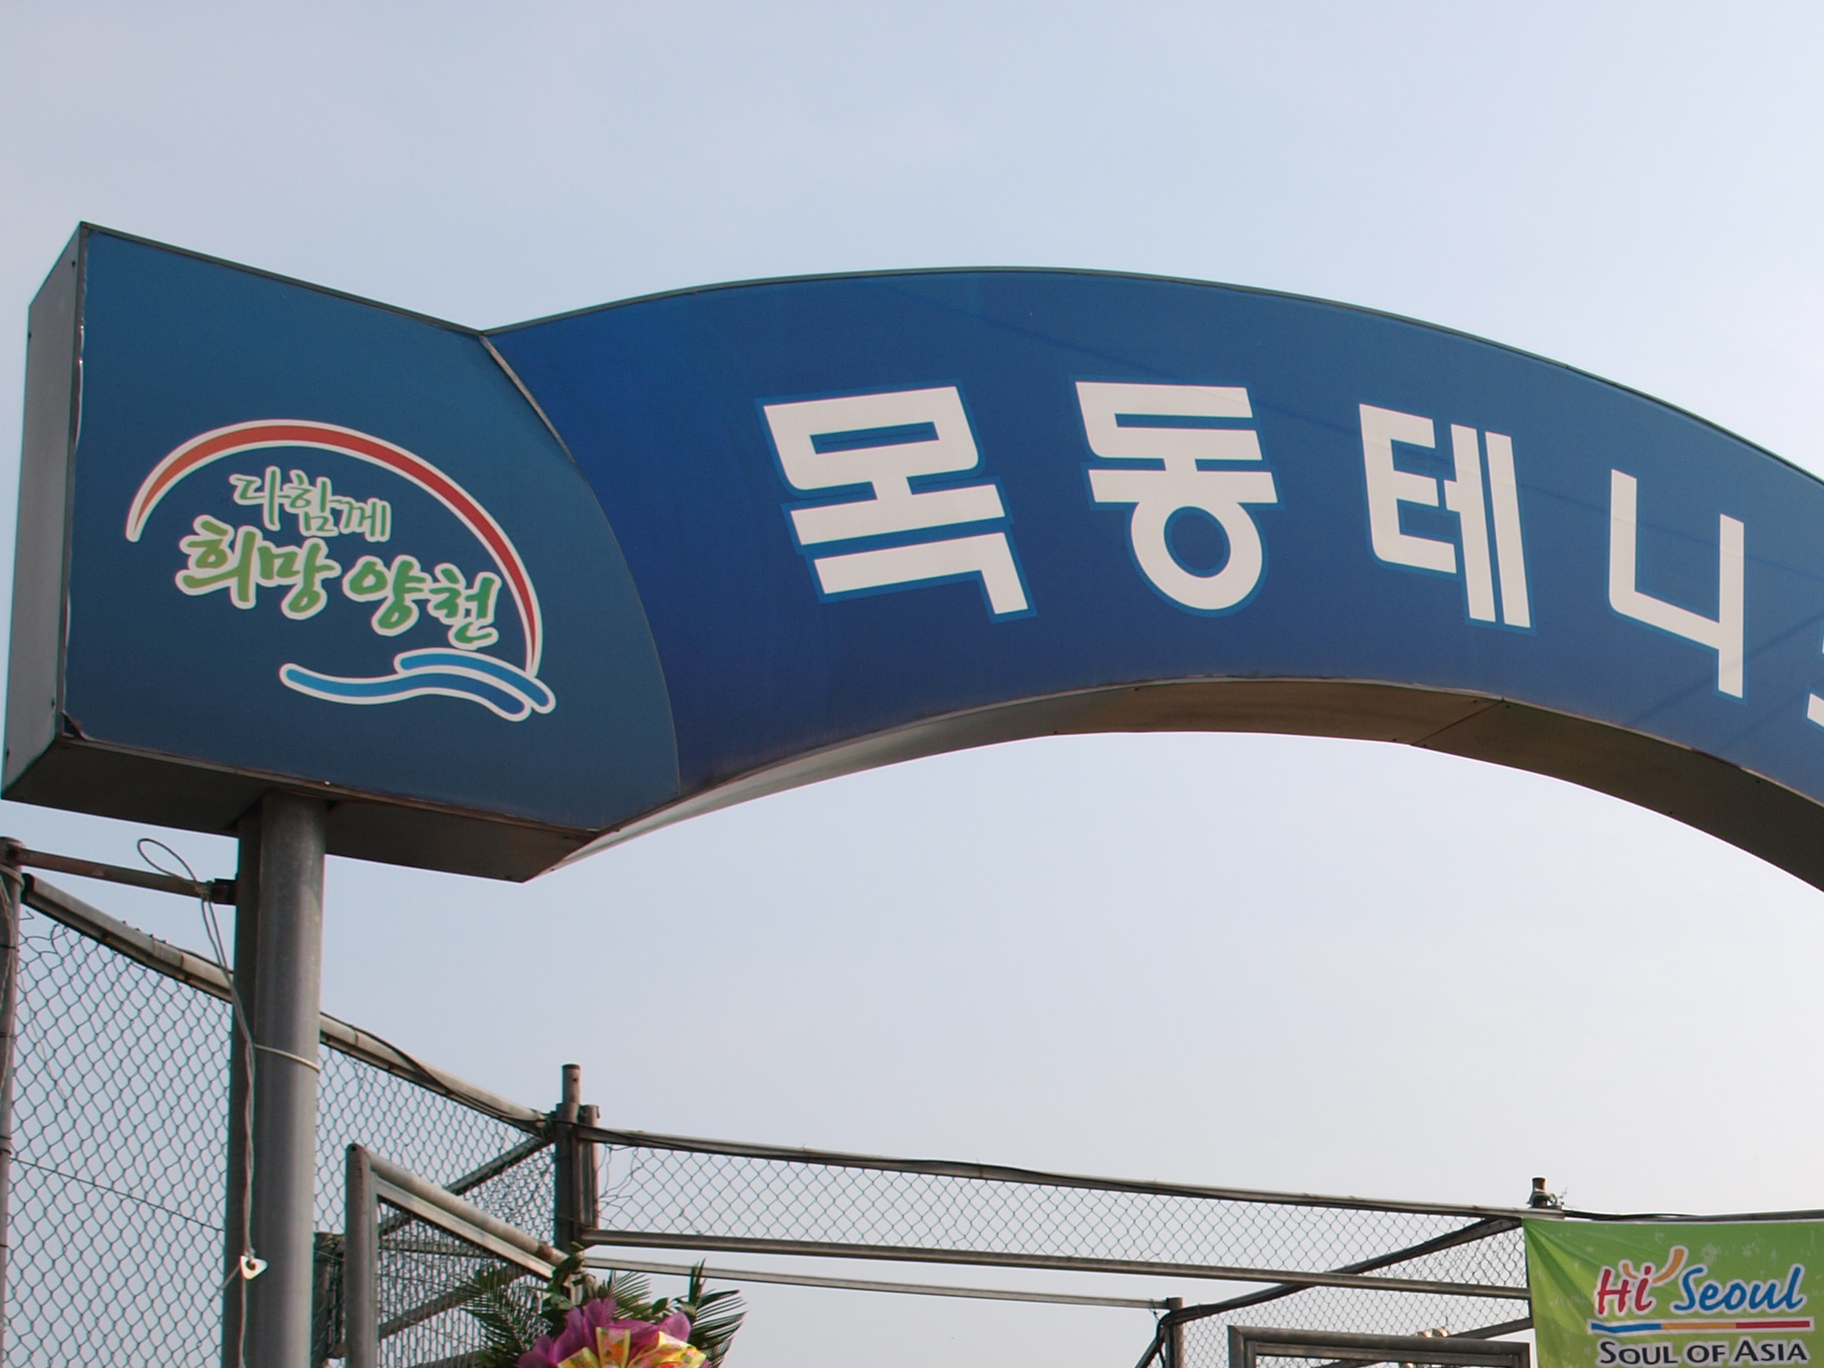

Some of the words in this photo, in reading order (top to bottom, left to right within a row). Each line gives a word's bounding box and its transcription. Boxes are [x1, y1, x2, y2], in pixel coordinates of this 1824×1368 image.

[230, 466, 391, 541] 다함께
[176, 514, 341, 620] 희망
[343, 553, 502, 650] 양천
[1596, 1262, 1656, 1316] Hi
[1671, 1265, 1807, 1313] Seoul
[1599, 1340, 1680, 1366] SOUL
[1686, 1342, 1727, 1364] OF
[1733, 1339, 1809, 1363] ASIA
